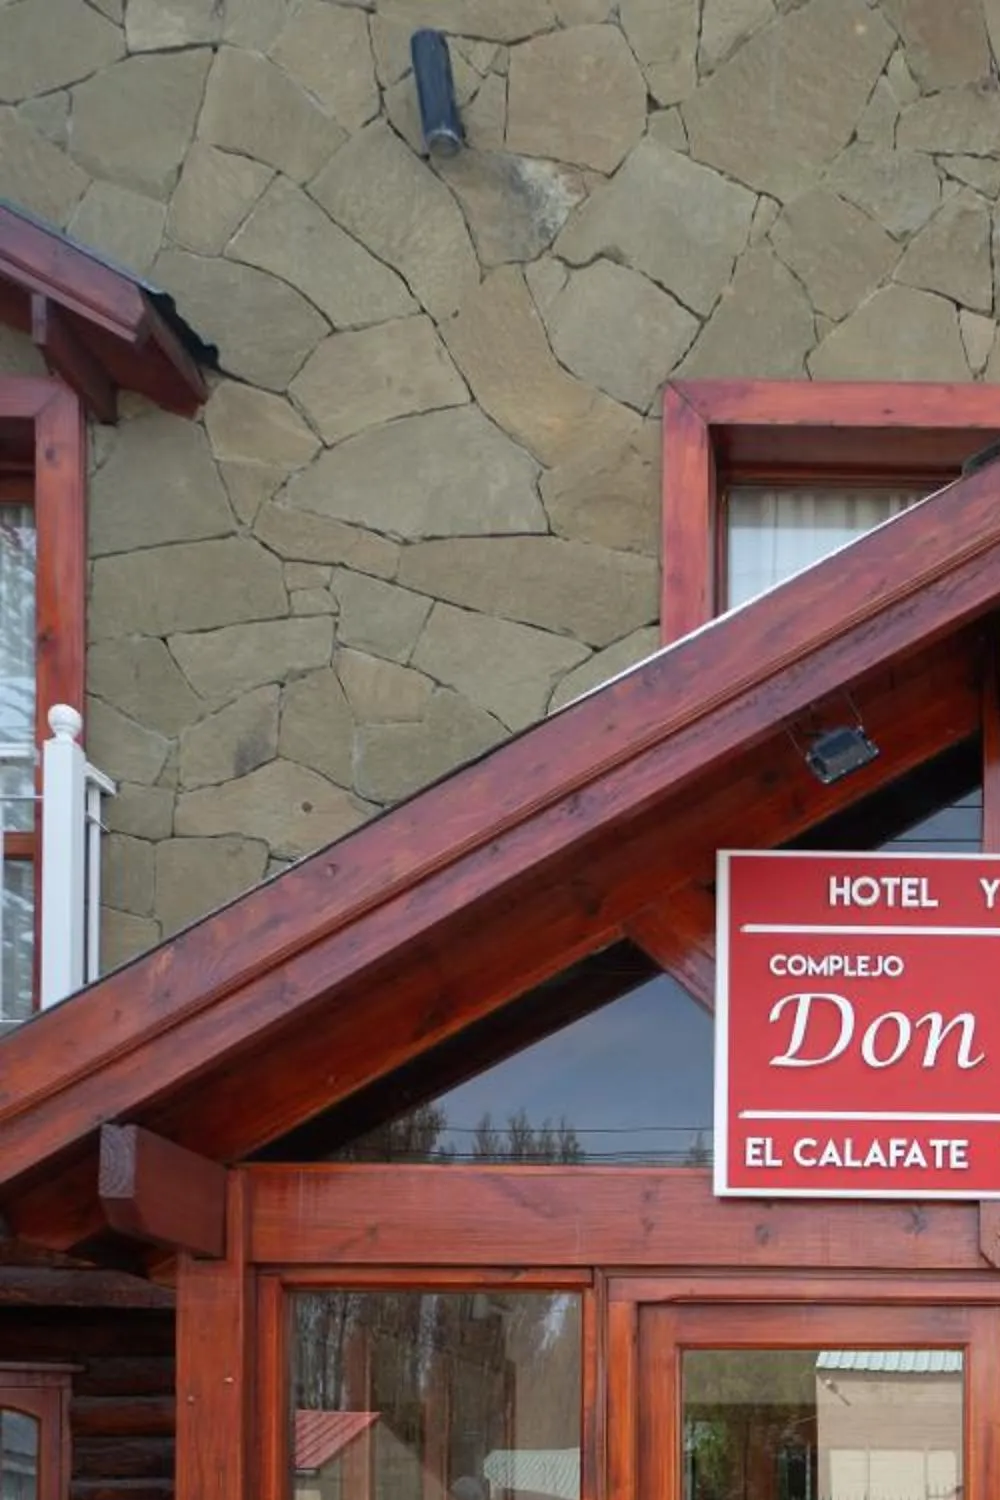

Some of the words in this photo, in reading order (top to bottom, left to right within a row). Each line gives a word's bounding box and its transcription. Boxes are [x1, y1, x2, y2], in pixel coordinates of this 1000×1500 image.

[829, 876, 939, 907] HOTEL
[979, 877, 1000, 909] Y
[769, 953, 905, 977] COMPLEJO
[768, 992, 986, 1070] Don
[745, 1136, 783, 1167] EL
[793, 1137, 969, 1169] CALAFATE
